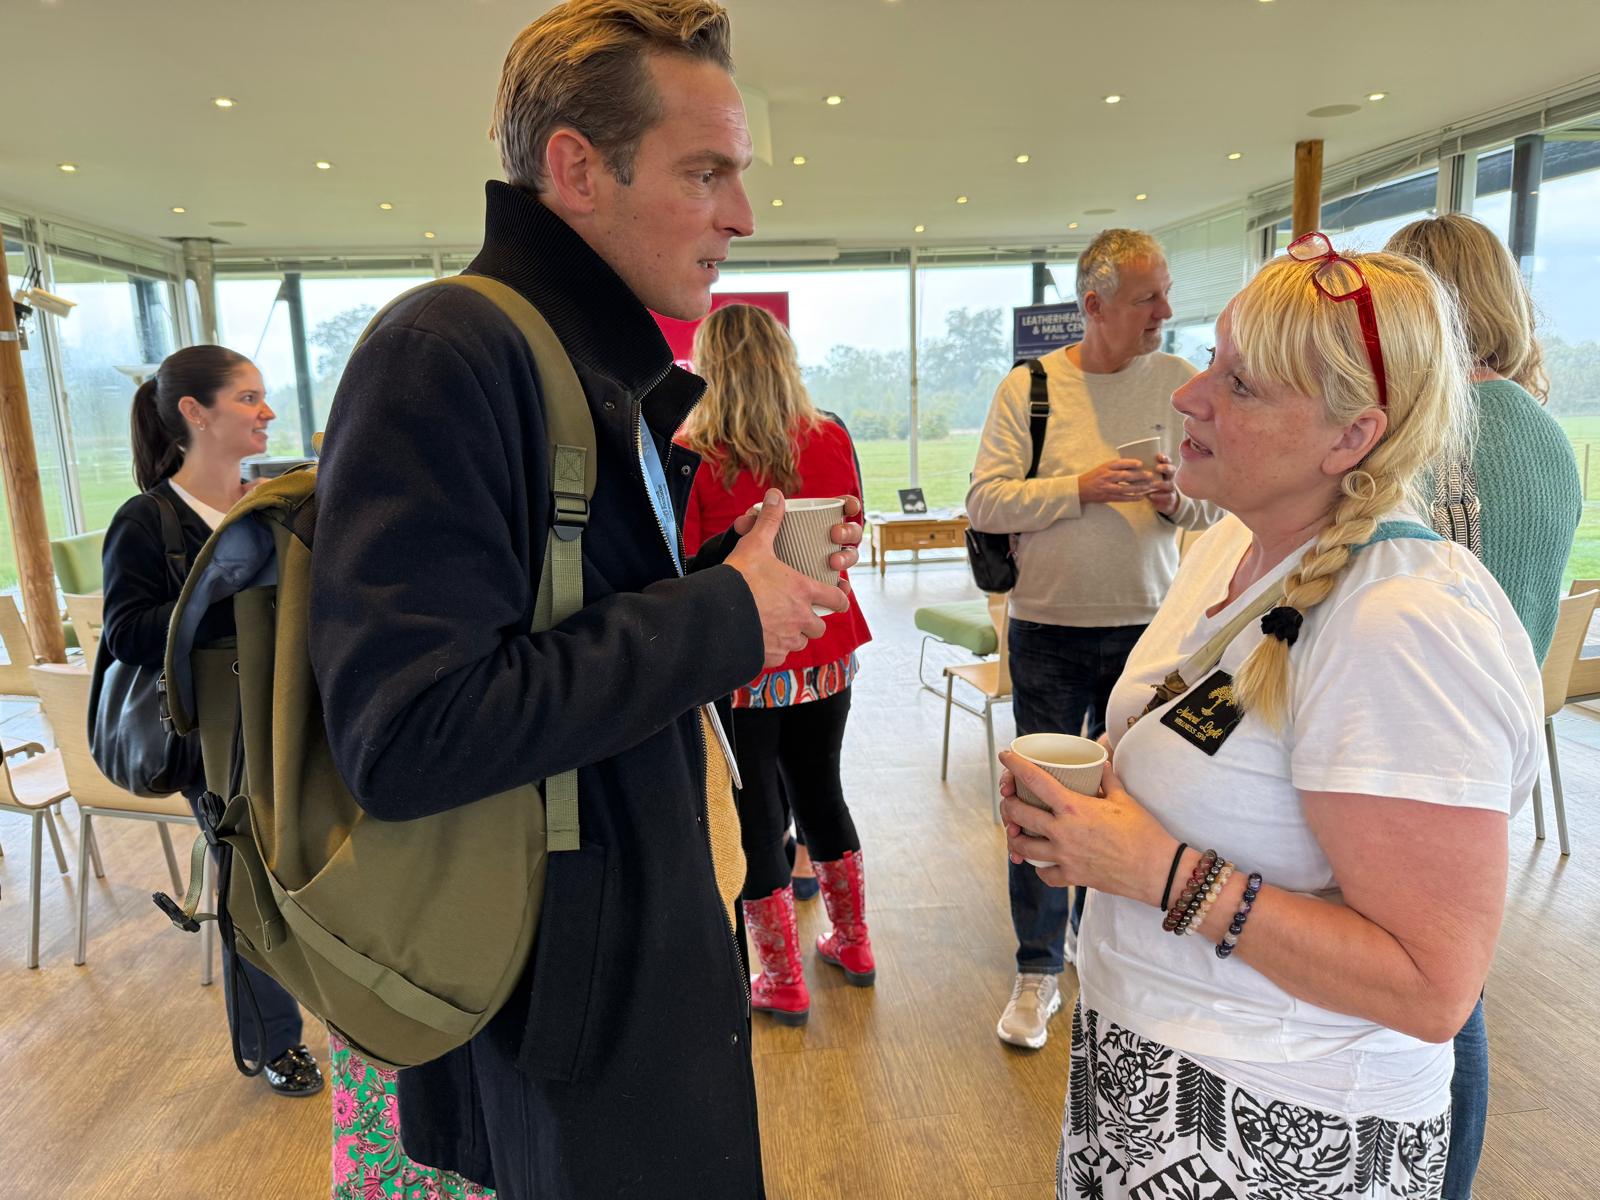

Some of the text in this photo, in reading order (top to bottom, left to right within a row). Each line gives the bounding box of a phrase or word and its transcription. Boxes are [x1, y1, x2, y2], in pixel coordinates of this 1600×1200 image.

[1032, 326, 1040, 335] &
[1174, 717, 1206, 742] WELLNESS SPA
[1200, 721, 1223, 738] Light
